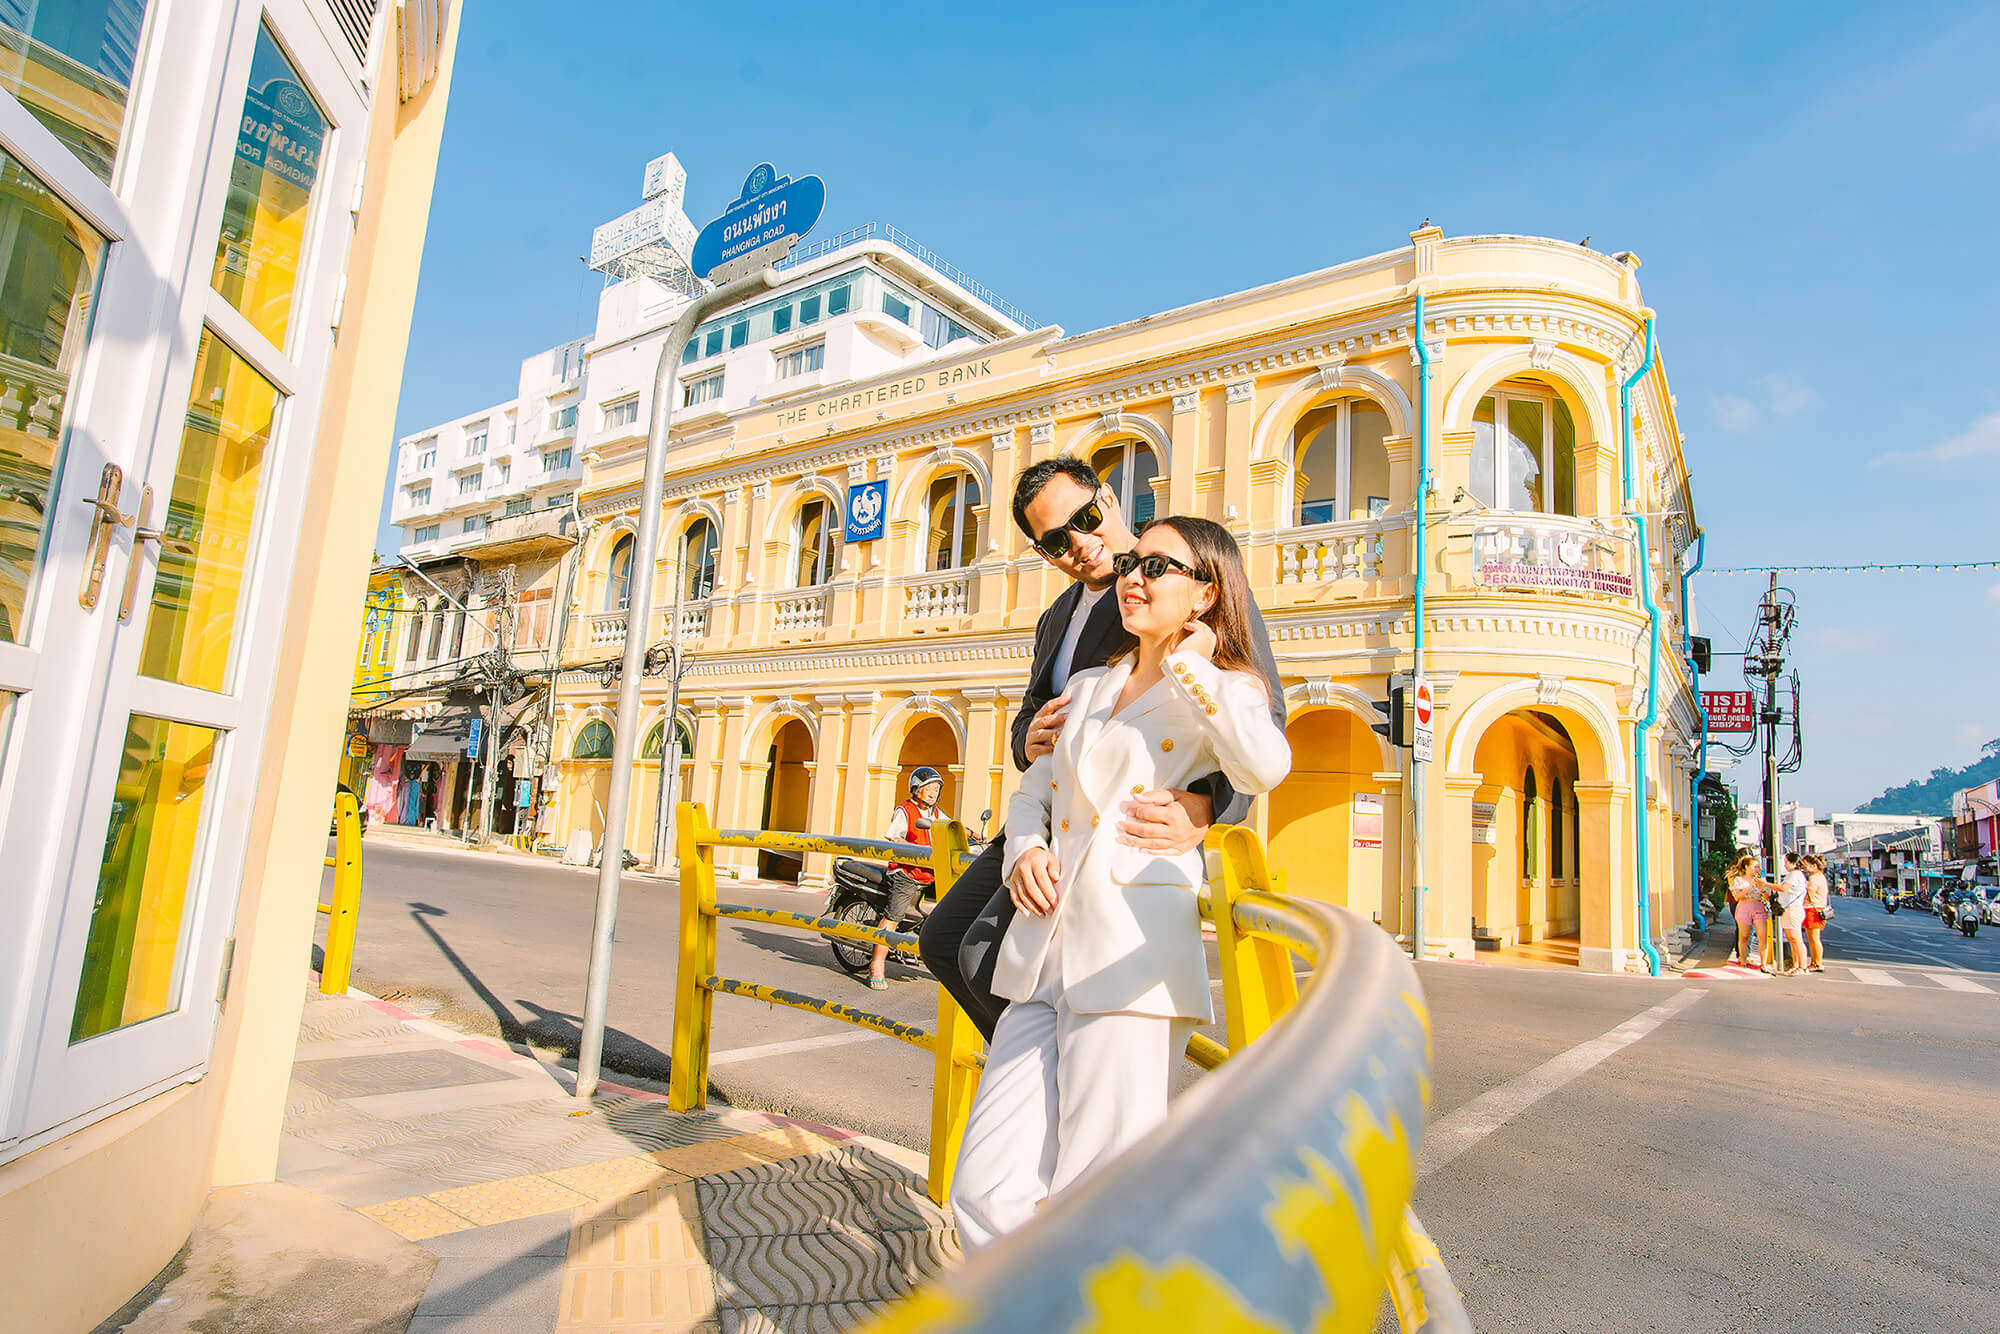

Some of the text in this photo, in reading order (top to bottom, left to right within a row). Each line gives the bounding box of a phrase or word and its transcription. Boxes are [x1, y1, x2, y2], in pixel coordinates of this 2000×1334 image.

[723, 199, 788, 243] ถนนพังงา
[721, 224, 785, 261] PHANGNGA ROAD
[776, 359, 993, 427] THE CHARTERED BANK
[1594, 581, 1633, 596] MUSEUM
